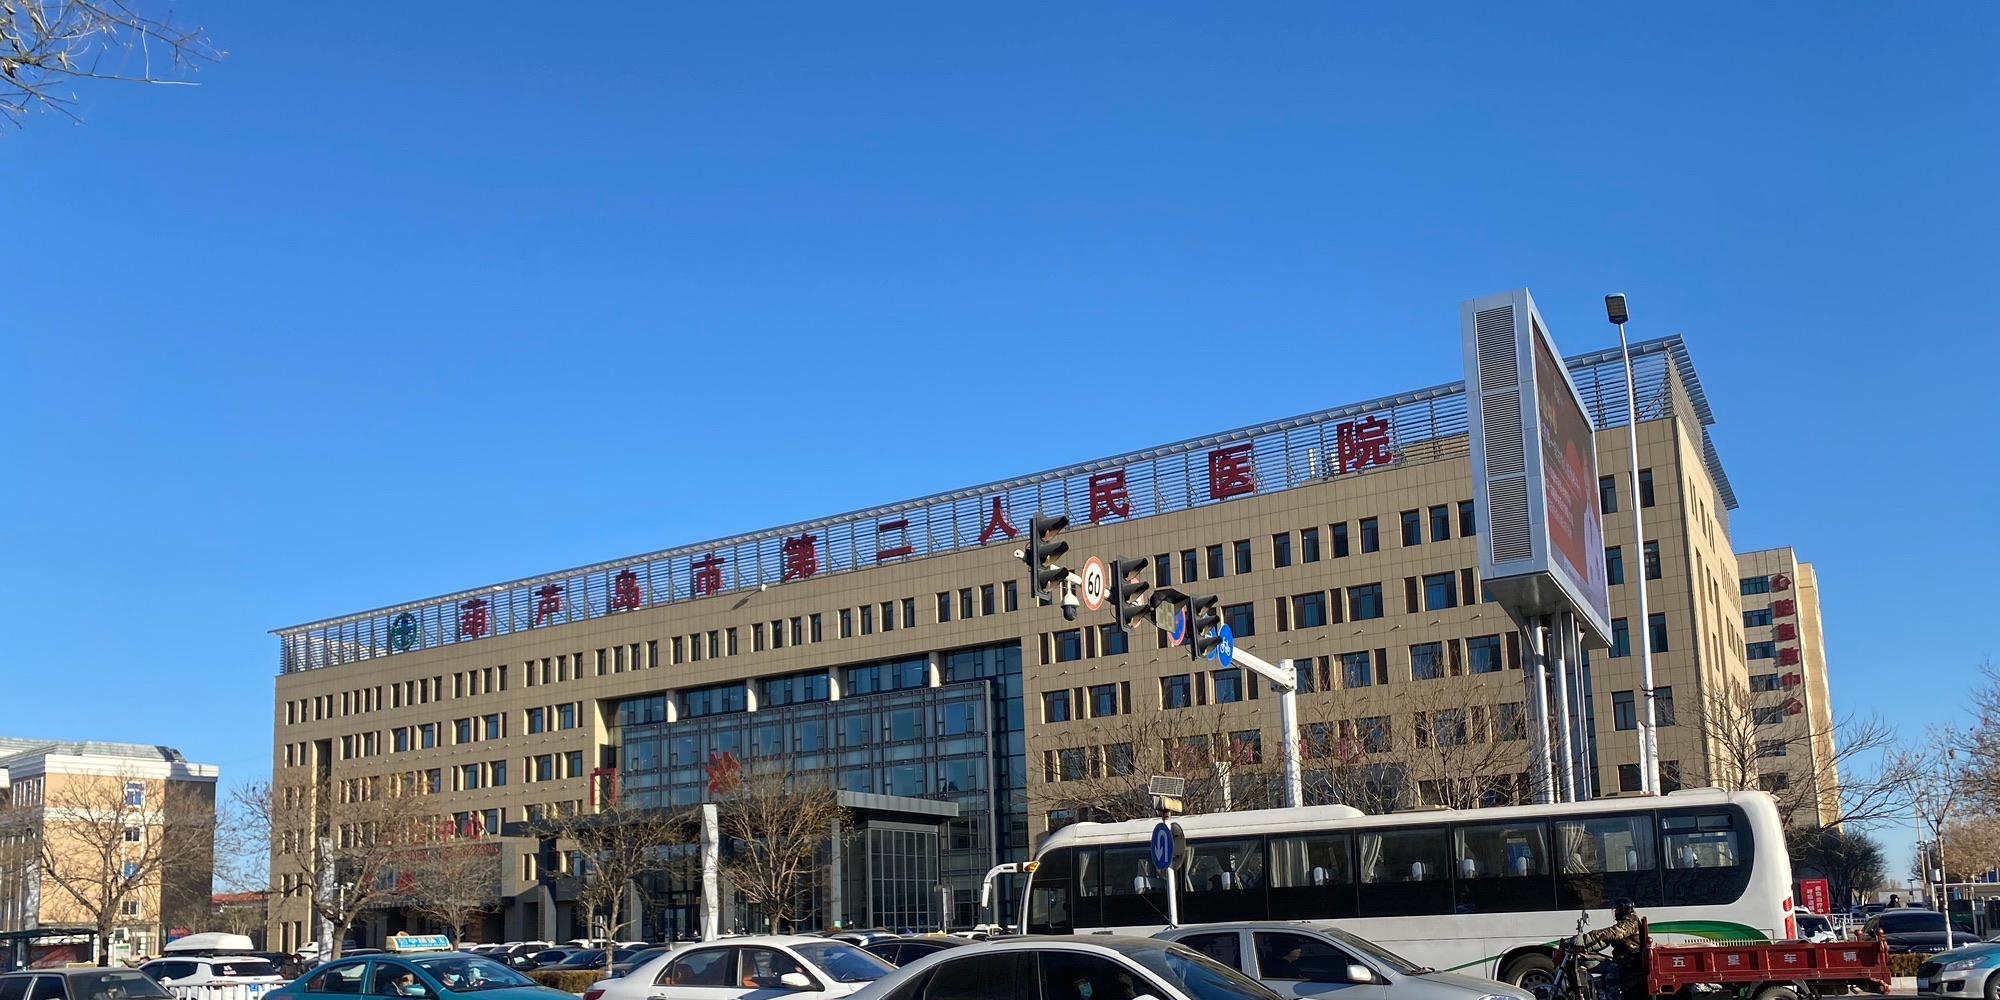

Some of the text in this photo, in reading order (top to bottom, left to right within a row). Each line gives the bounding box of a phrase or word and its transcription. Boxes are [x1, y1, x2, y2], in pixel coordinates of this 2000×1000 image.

[459, 415, 1393, 640] 葫芦岛市第二人民医院
[1088, 571, 1100, 597] 60
[1672, 951, 1857, 967] 五星车辆
